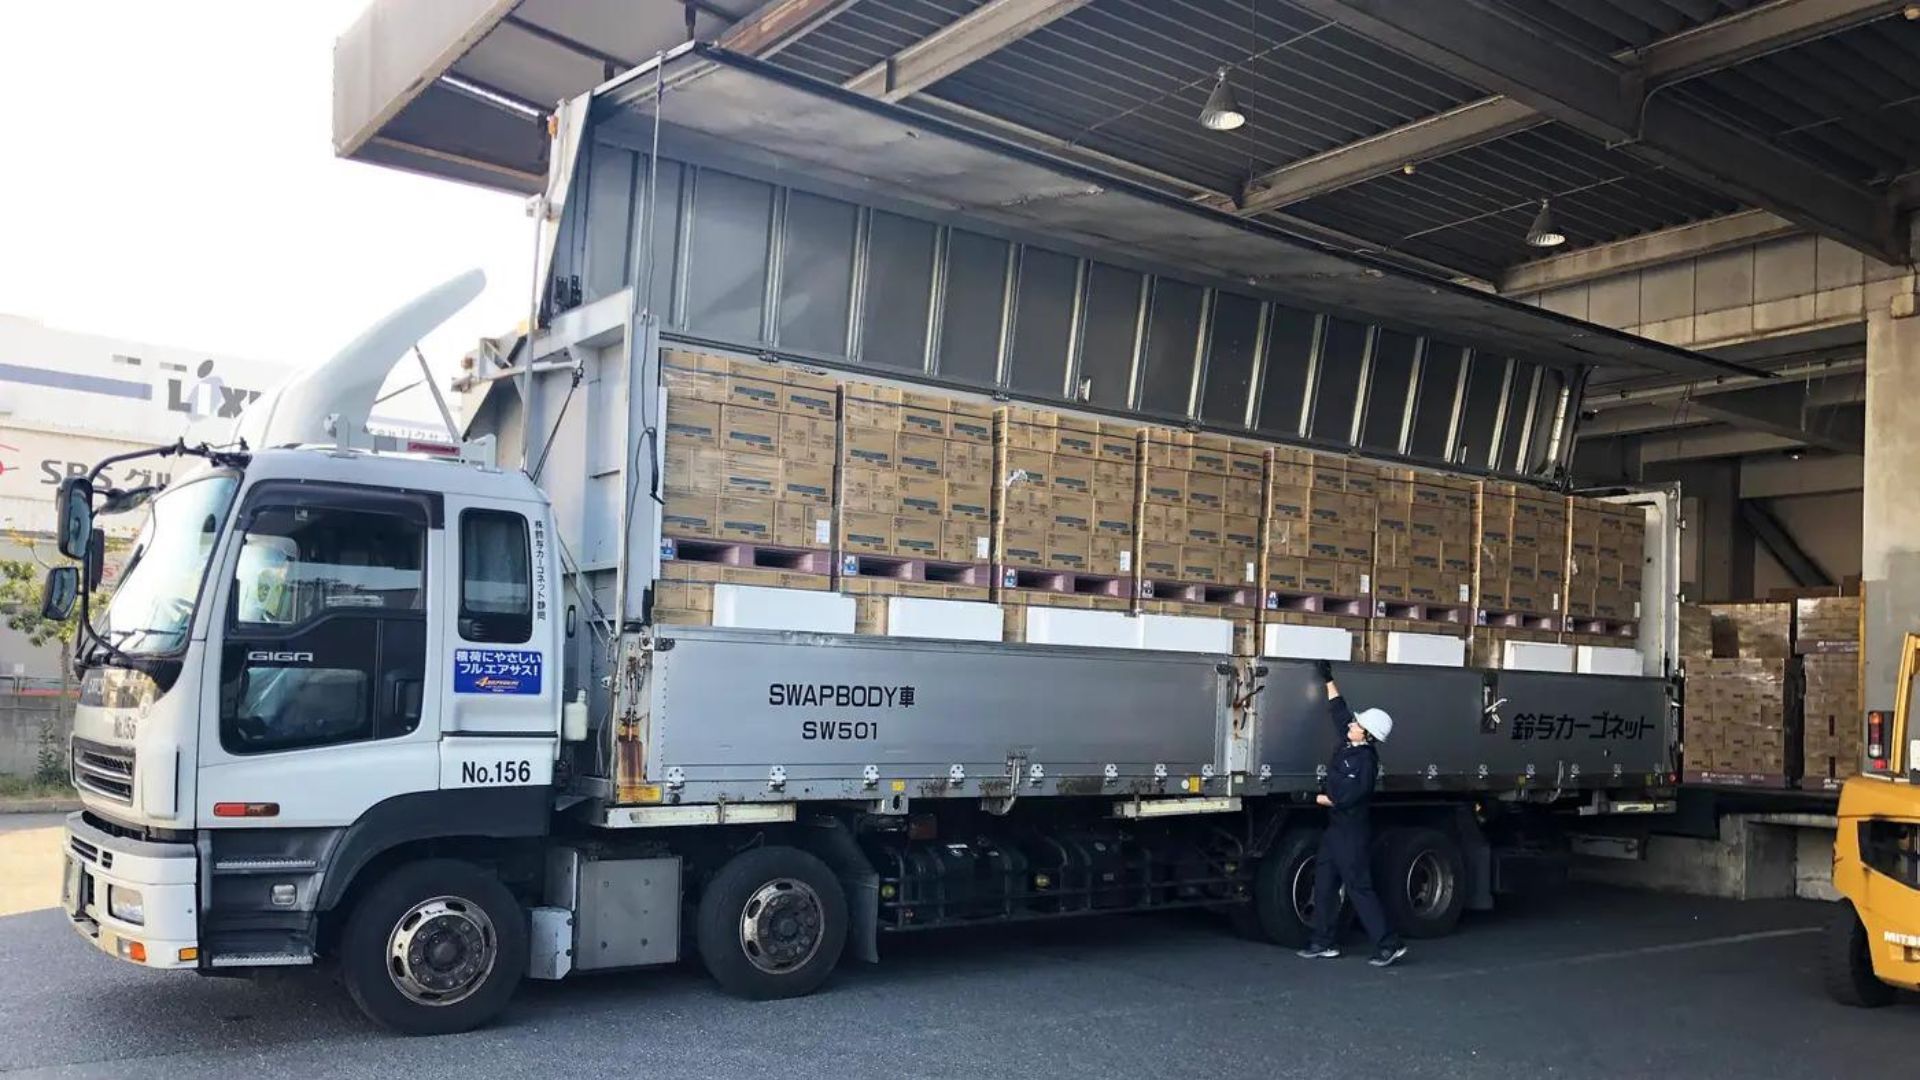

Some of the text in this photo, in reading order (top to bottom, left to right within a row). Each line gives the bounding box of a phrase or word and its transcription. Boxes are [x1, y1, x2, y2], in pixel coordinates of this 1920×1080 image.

[247, 651, 314, 662] GIGA
[802, 721, 878, 740] SW501
[1511, 710, 1656, 740] 鈴与カーゴネット
[462, 760, 531, 783] No.156
